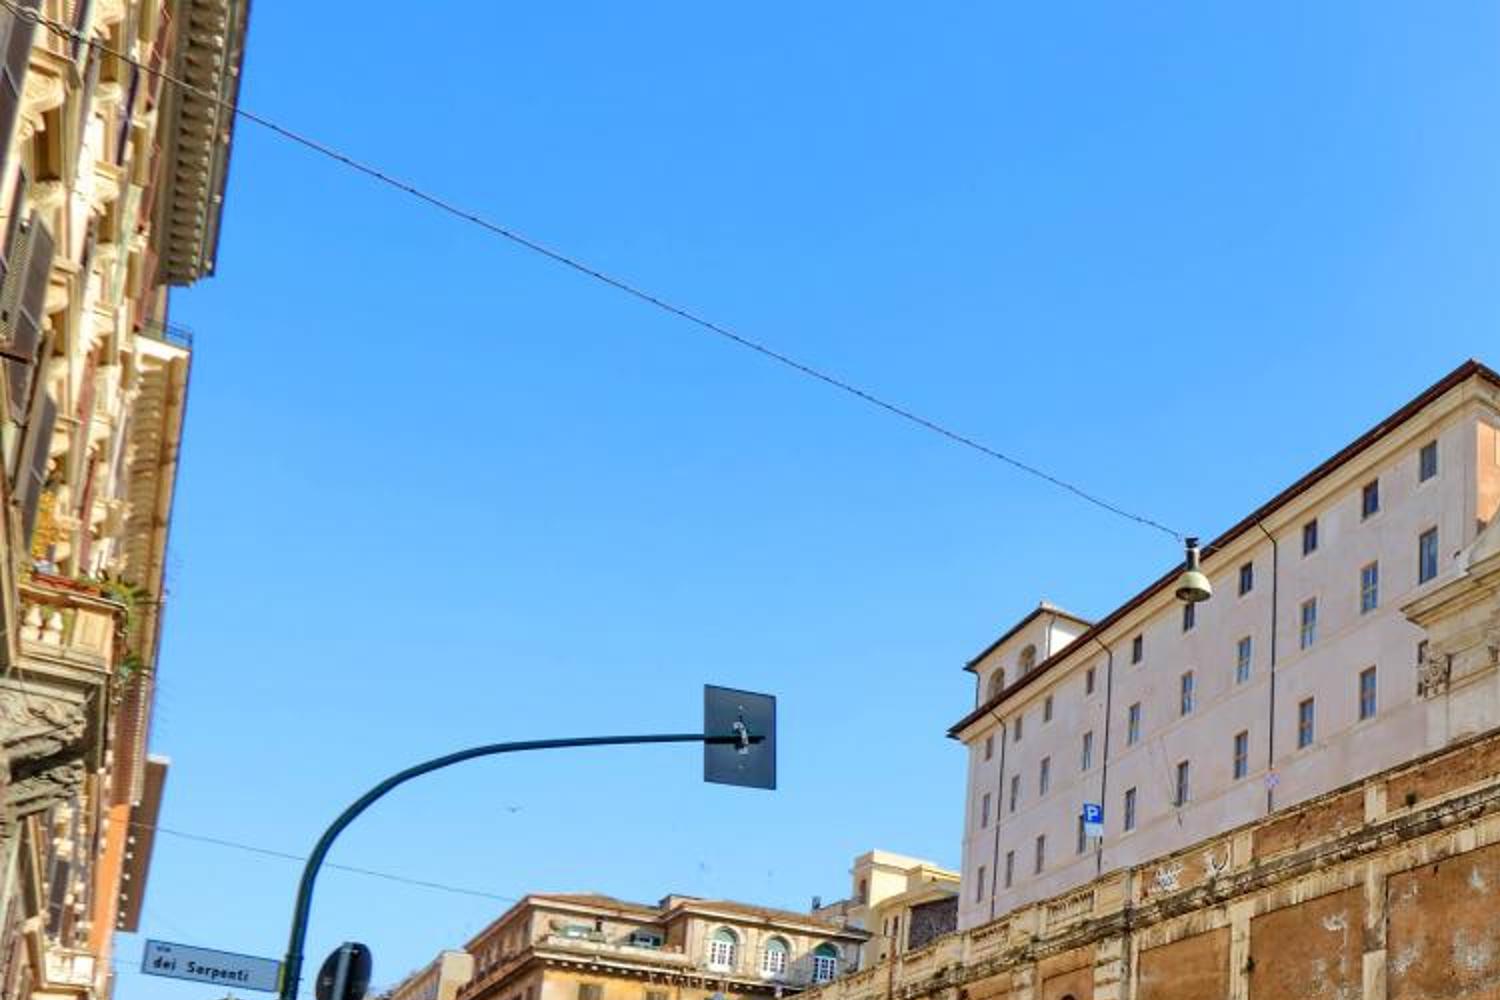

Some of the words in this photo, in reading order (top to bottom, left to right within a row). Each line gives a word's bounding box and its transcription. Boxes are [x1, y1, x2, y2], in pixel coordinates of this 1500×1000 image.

[1087, 805, 1099, 821] P
[153, 956, 176, 971] dei
[186, 961, 249, 982] Serpenti
